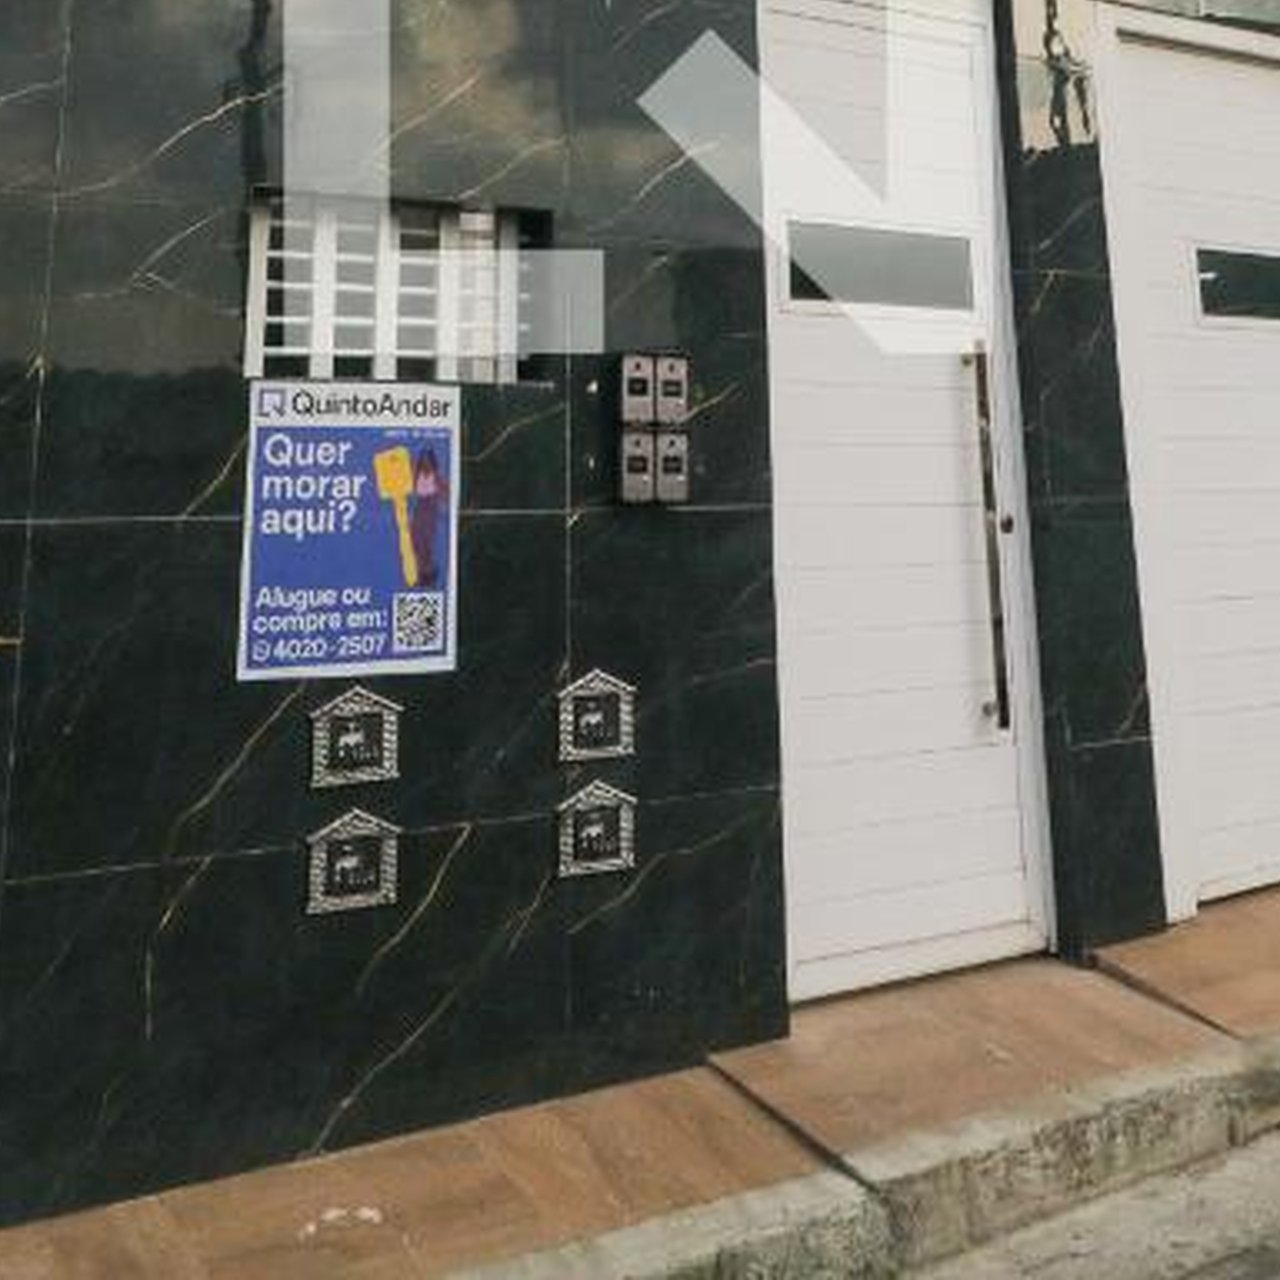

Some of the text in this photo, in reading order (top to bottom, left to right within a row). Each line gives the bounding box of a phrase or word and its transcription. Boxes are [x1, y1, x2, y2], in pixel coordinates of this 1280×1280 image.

[292, 391, 451, 418] QuintoAndar
[264, 434, 352, 467] Quer
[261, 473, 367, 499] morar
[260, 500, 357, 541] aqui?
[255, 586, 369, 611] Alugue ou
[252, 609, 388, 637] compre em:
[273, 636, 386, 660] 4020-2507
